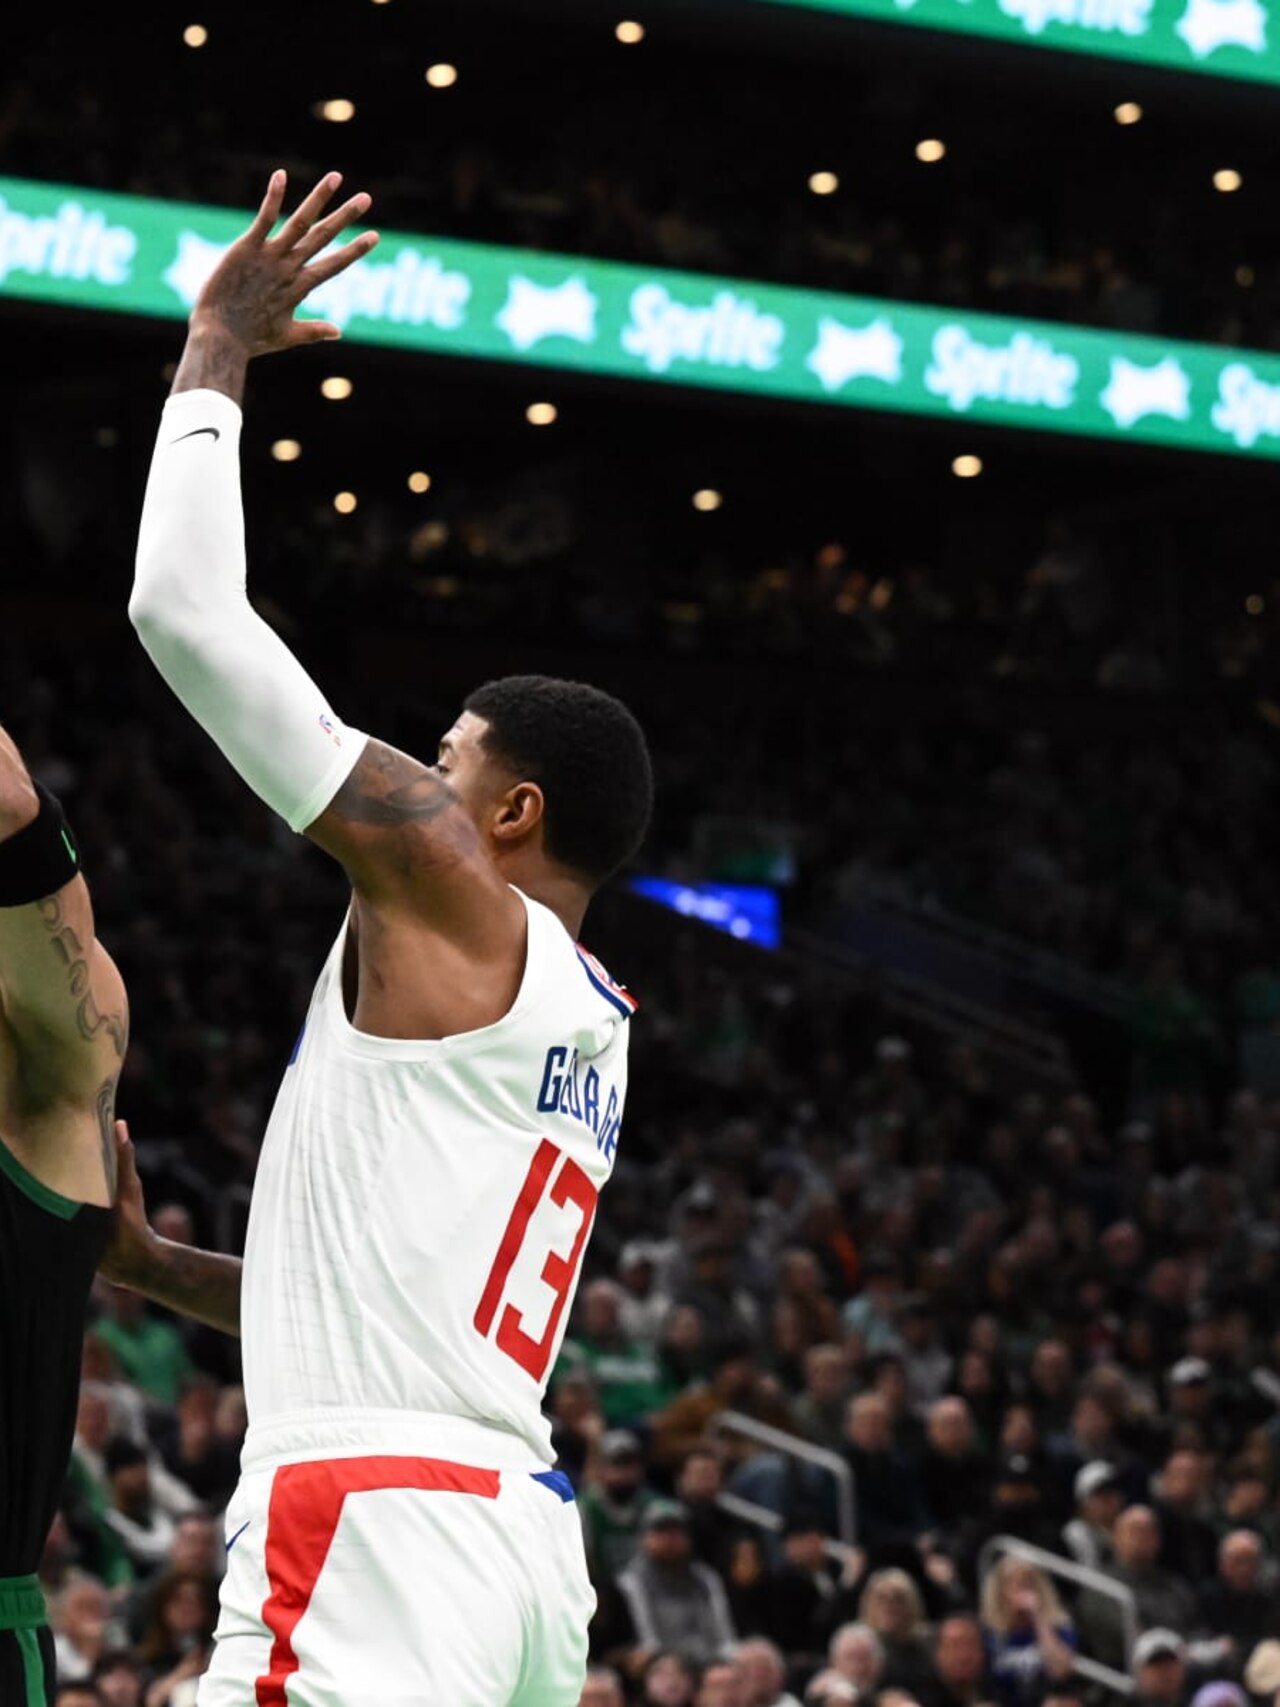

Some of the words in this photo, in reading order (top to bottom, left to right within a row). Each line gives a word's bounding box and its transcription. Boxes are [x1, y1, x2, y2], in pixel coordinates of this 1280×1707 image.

[620, 283, 786, 371] Sprite
[925, 324, 1079, 410] Sprite
[473, 1137, 598, 1383] 13
